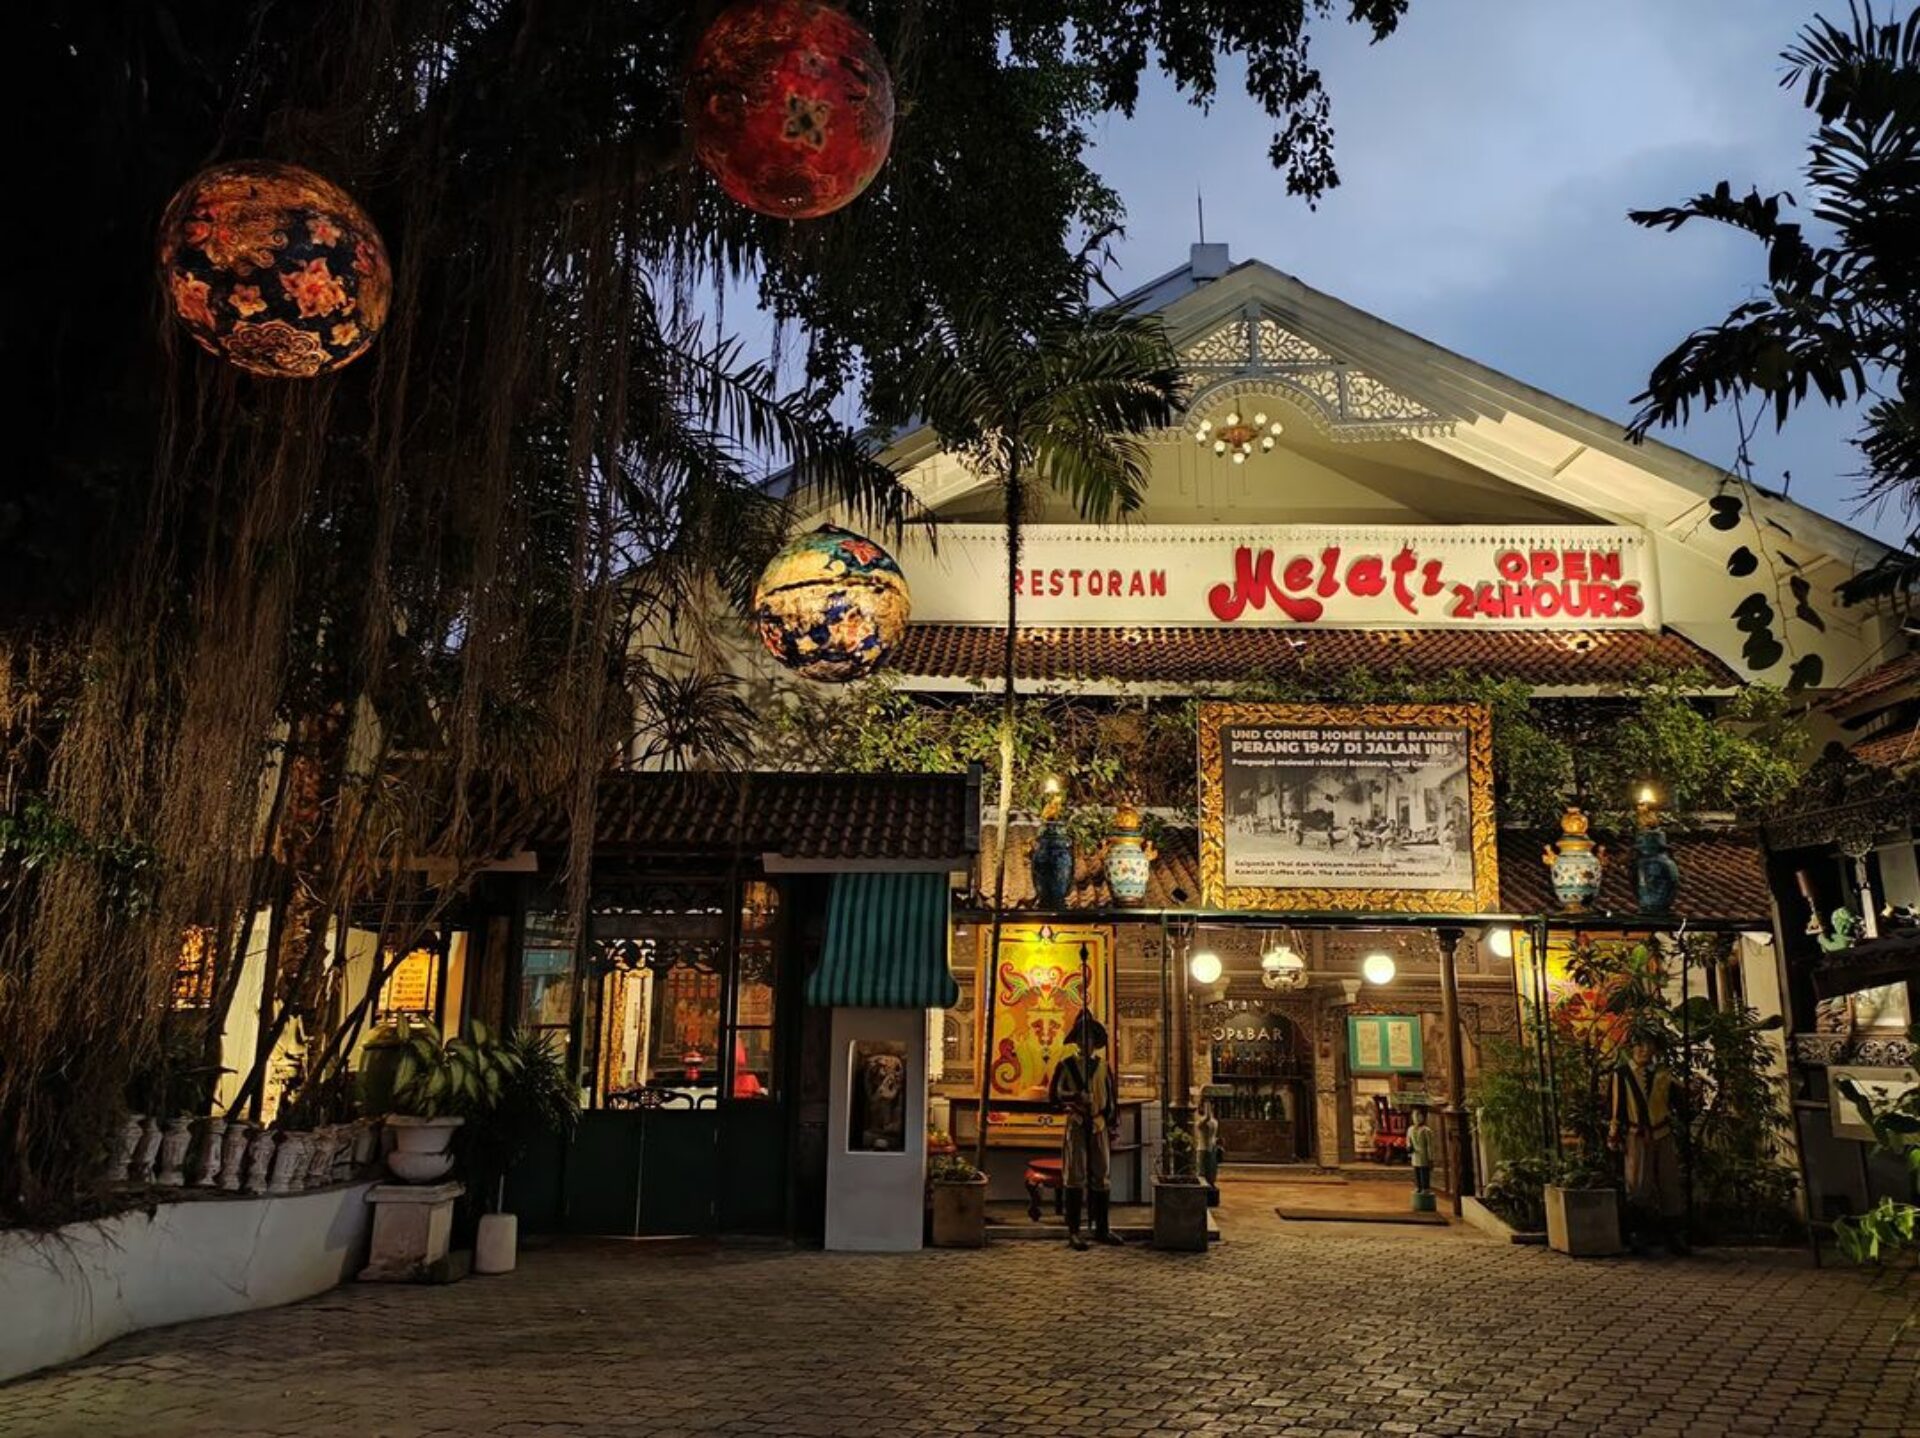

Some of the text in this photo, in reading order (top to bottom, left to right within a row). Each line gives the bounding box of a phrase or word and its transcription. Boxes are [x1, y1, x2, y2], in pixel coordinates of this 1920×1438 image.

[1499, 550, 1622, 581] OPEN
[1013, 545, 1444, 622] RESTORAN Melati
[1231, 729, 1463, 742] UND CORNER HOME MADE BAKERY
[1231, 740, 1449, 755] PERANG 1947 DI JALAN INI
